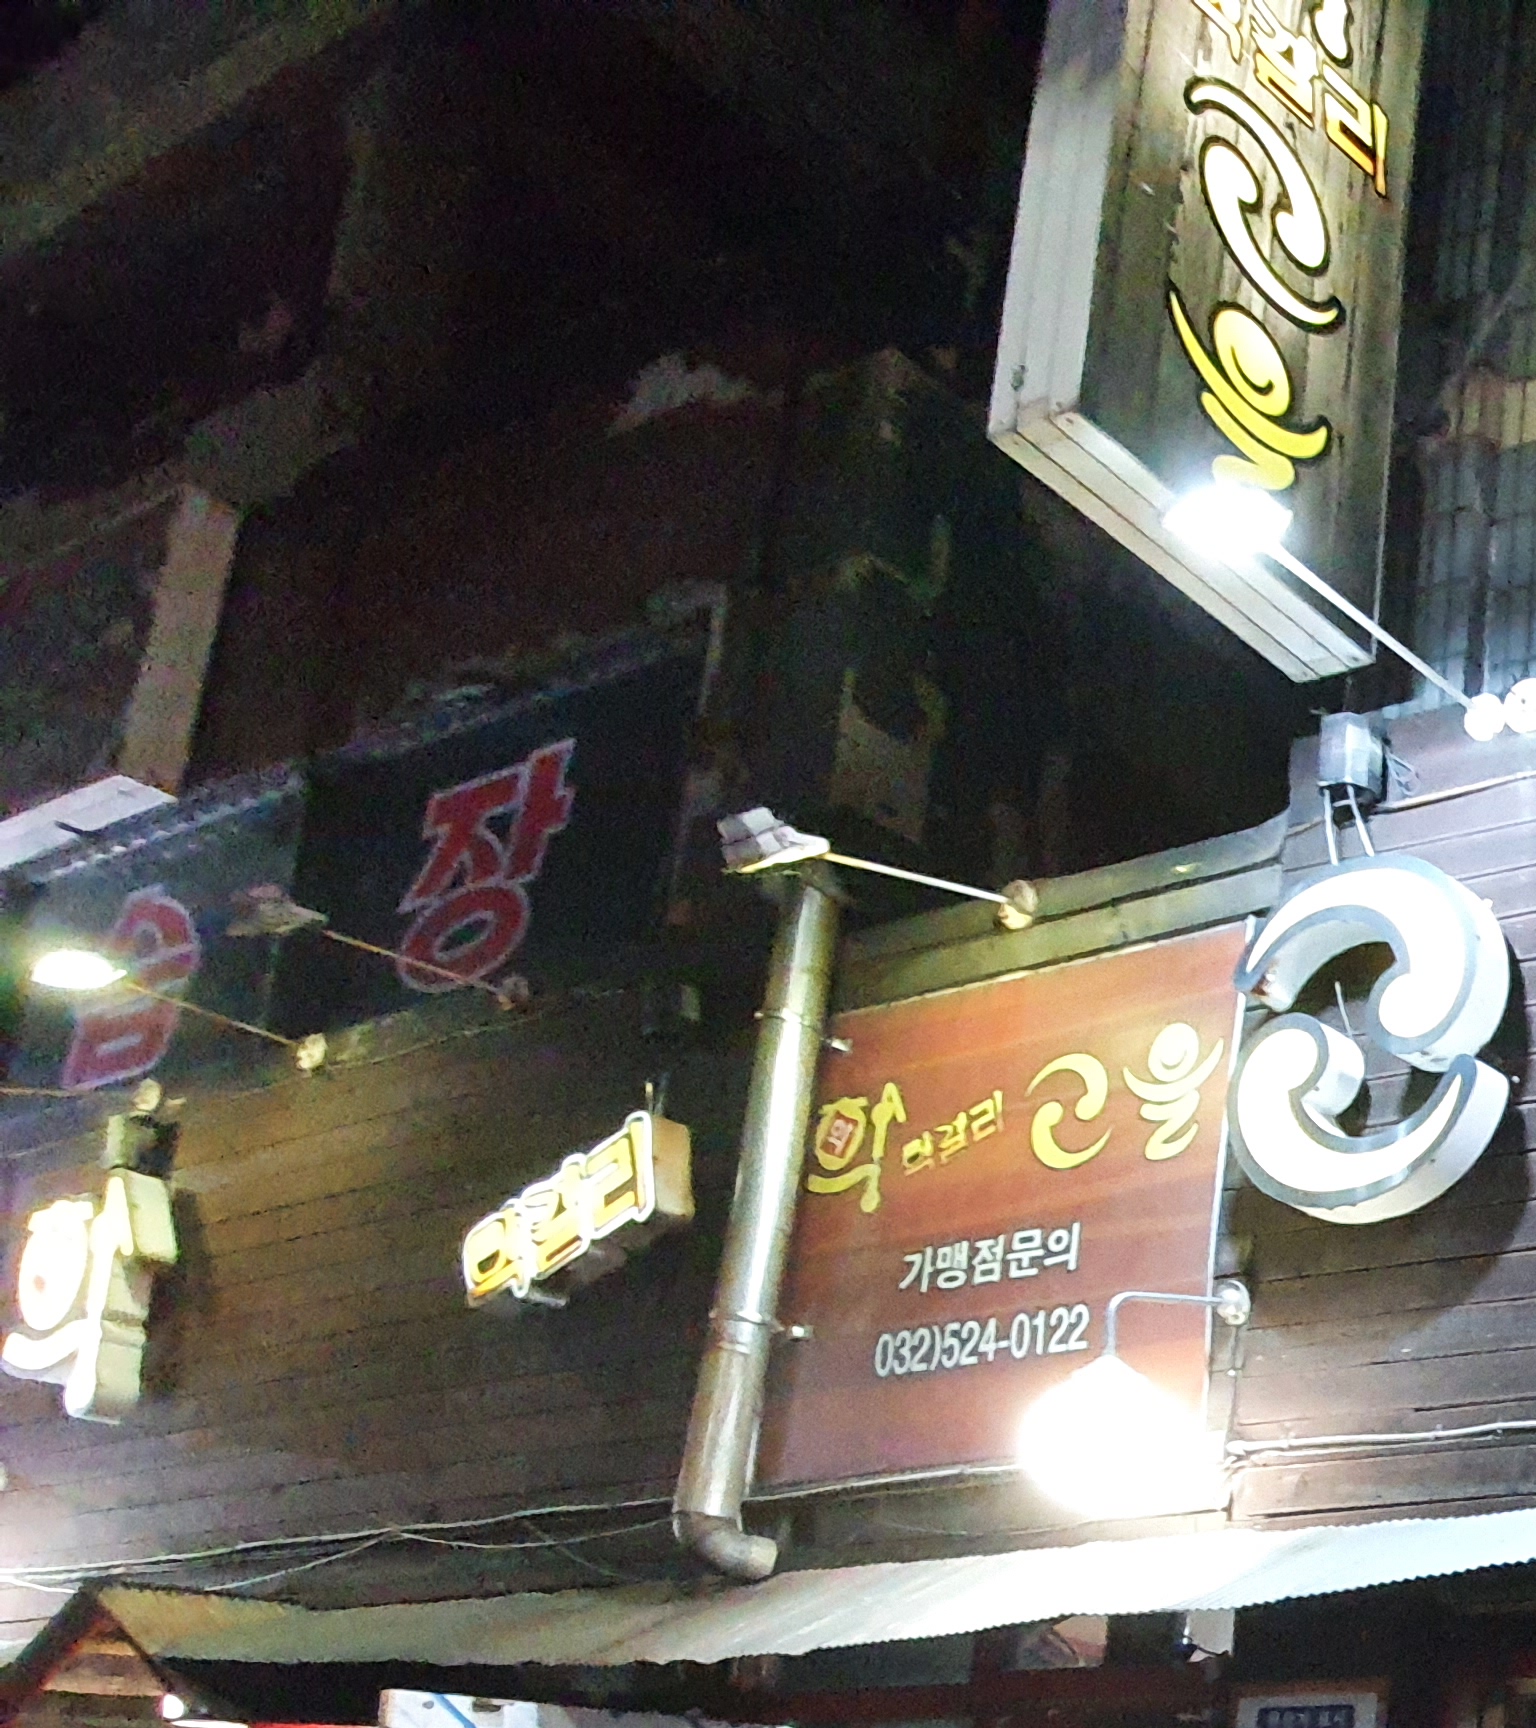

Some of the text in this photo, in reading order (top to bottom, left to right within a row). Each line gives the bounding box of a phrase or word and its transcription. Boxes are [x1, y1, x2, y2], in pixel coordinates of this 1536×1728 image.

[396, 737, 579, 992] 장
[897, 1221, 1083, 1293] 가맹점문의
[873, 1303, 1091, 1377] 032)524-0122
